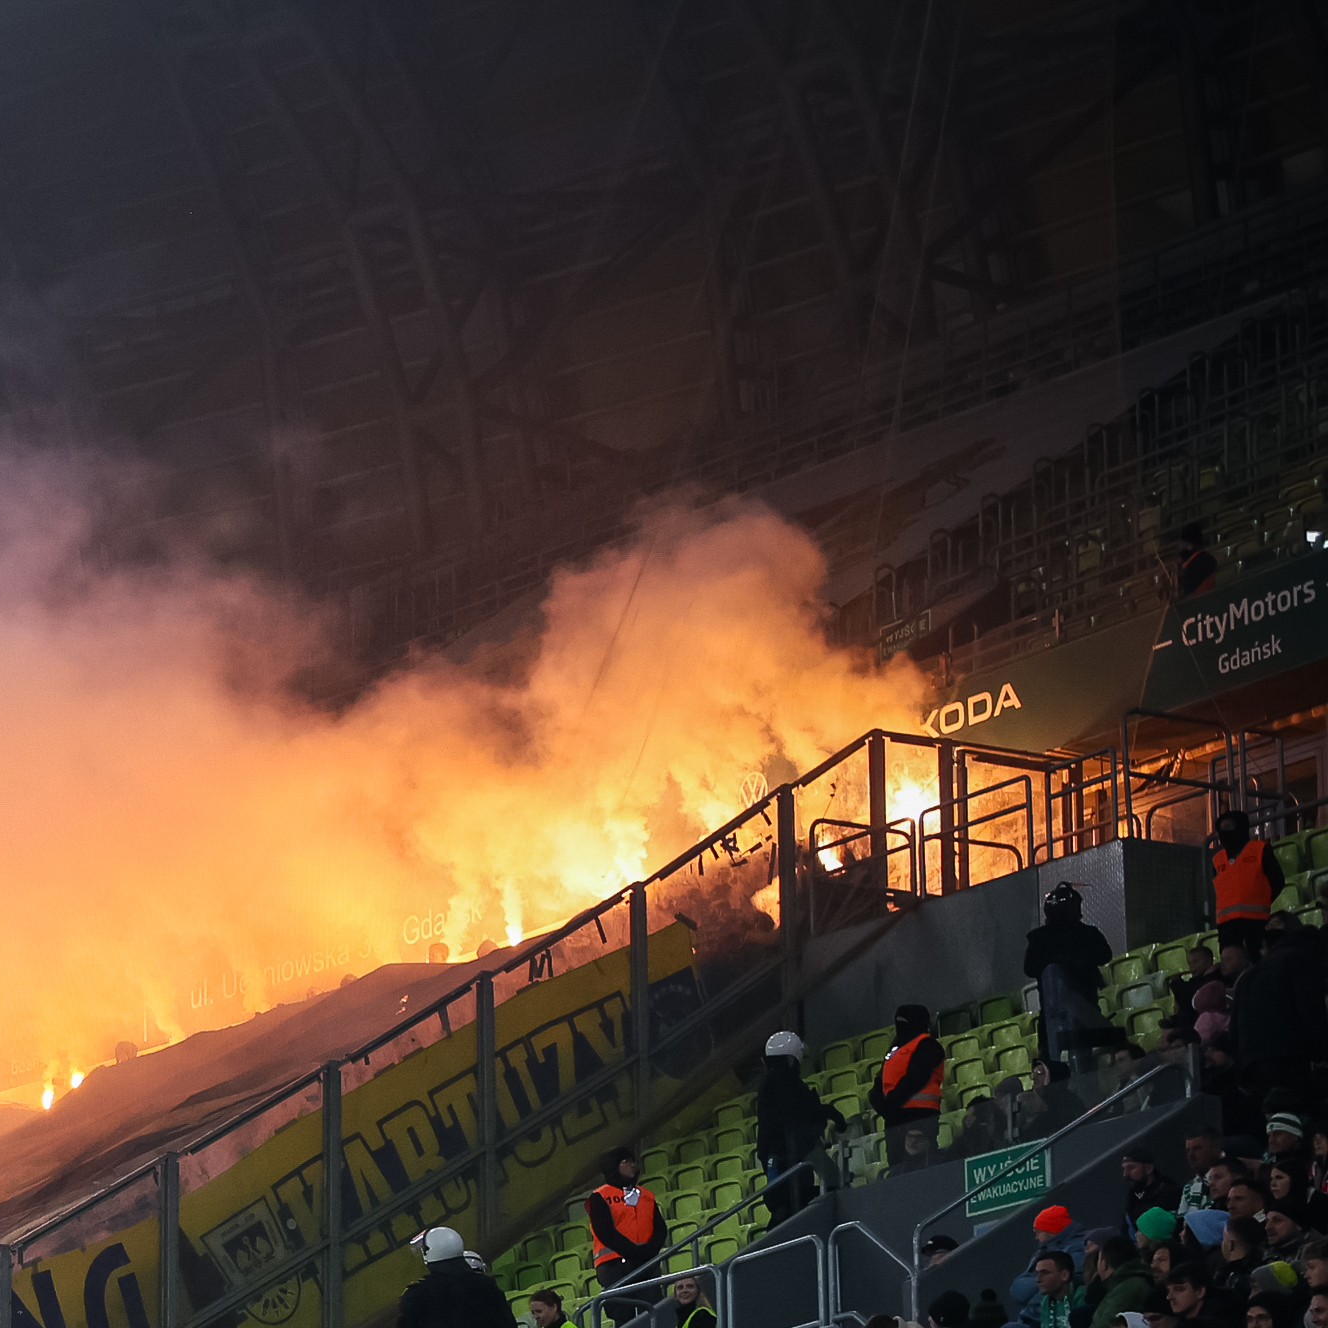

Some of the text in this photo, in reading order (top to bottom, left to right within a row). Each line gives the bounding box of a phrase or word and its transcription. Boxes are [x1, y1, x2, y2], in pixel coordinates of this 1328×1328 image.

[1182, 580, 1316, 649] CityMotors
[1217, 634, 1282, 673] Gdańsk
[920, 683, 1022, 737] KODA
[191, 983, 213, 1009] ul.
[222, 945, 350, 999] Ucniowska
[272, 989, 641, 1290] KARTUZY
